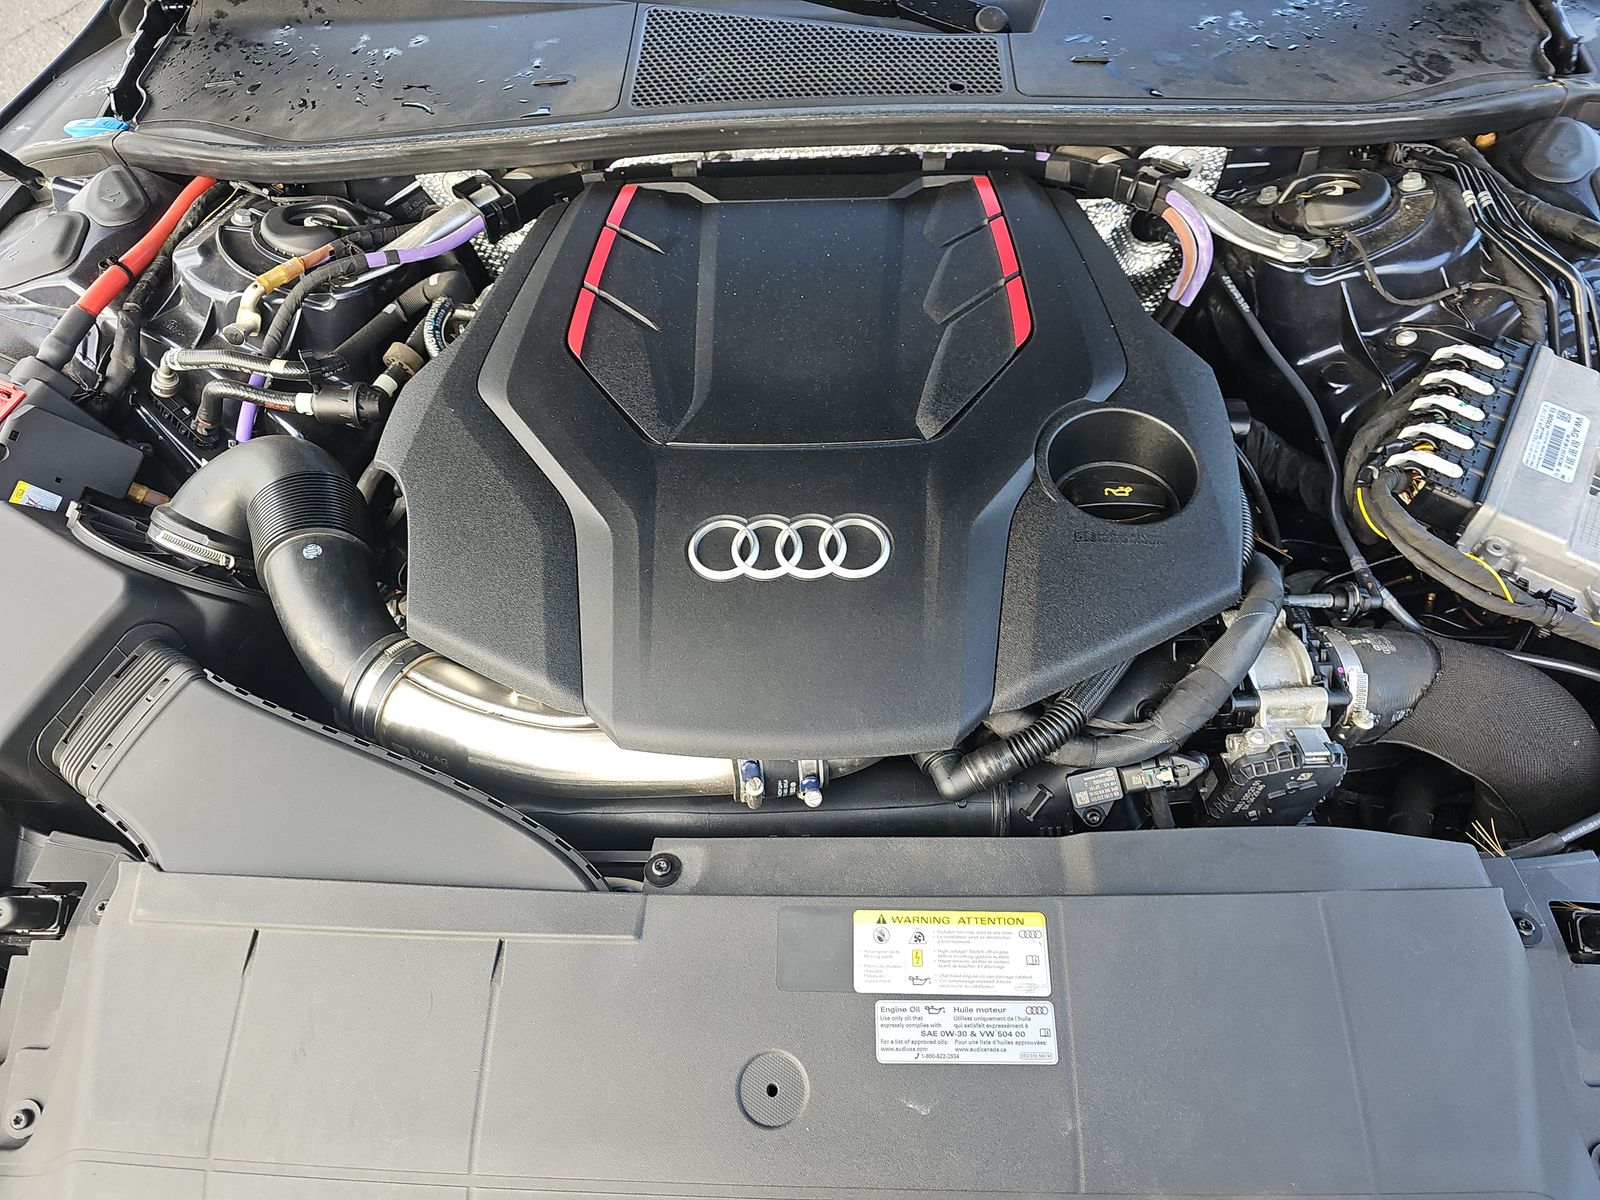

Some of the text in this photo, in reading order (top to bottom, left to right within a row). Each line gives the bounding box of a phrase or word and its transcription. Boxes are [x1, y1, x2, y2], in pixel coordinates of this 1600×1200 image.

[1574, 416, 1584, 428] VW
[1570, 427, 1580, 438] AG
[891, 916, 1025, 926] WARNING ATTENTION
[880, 1006, 907, 1014] Engine
